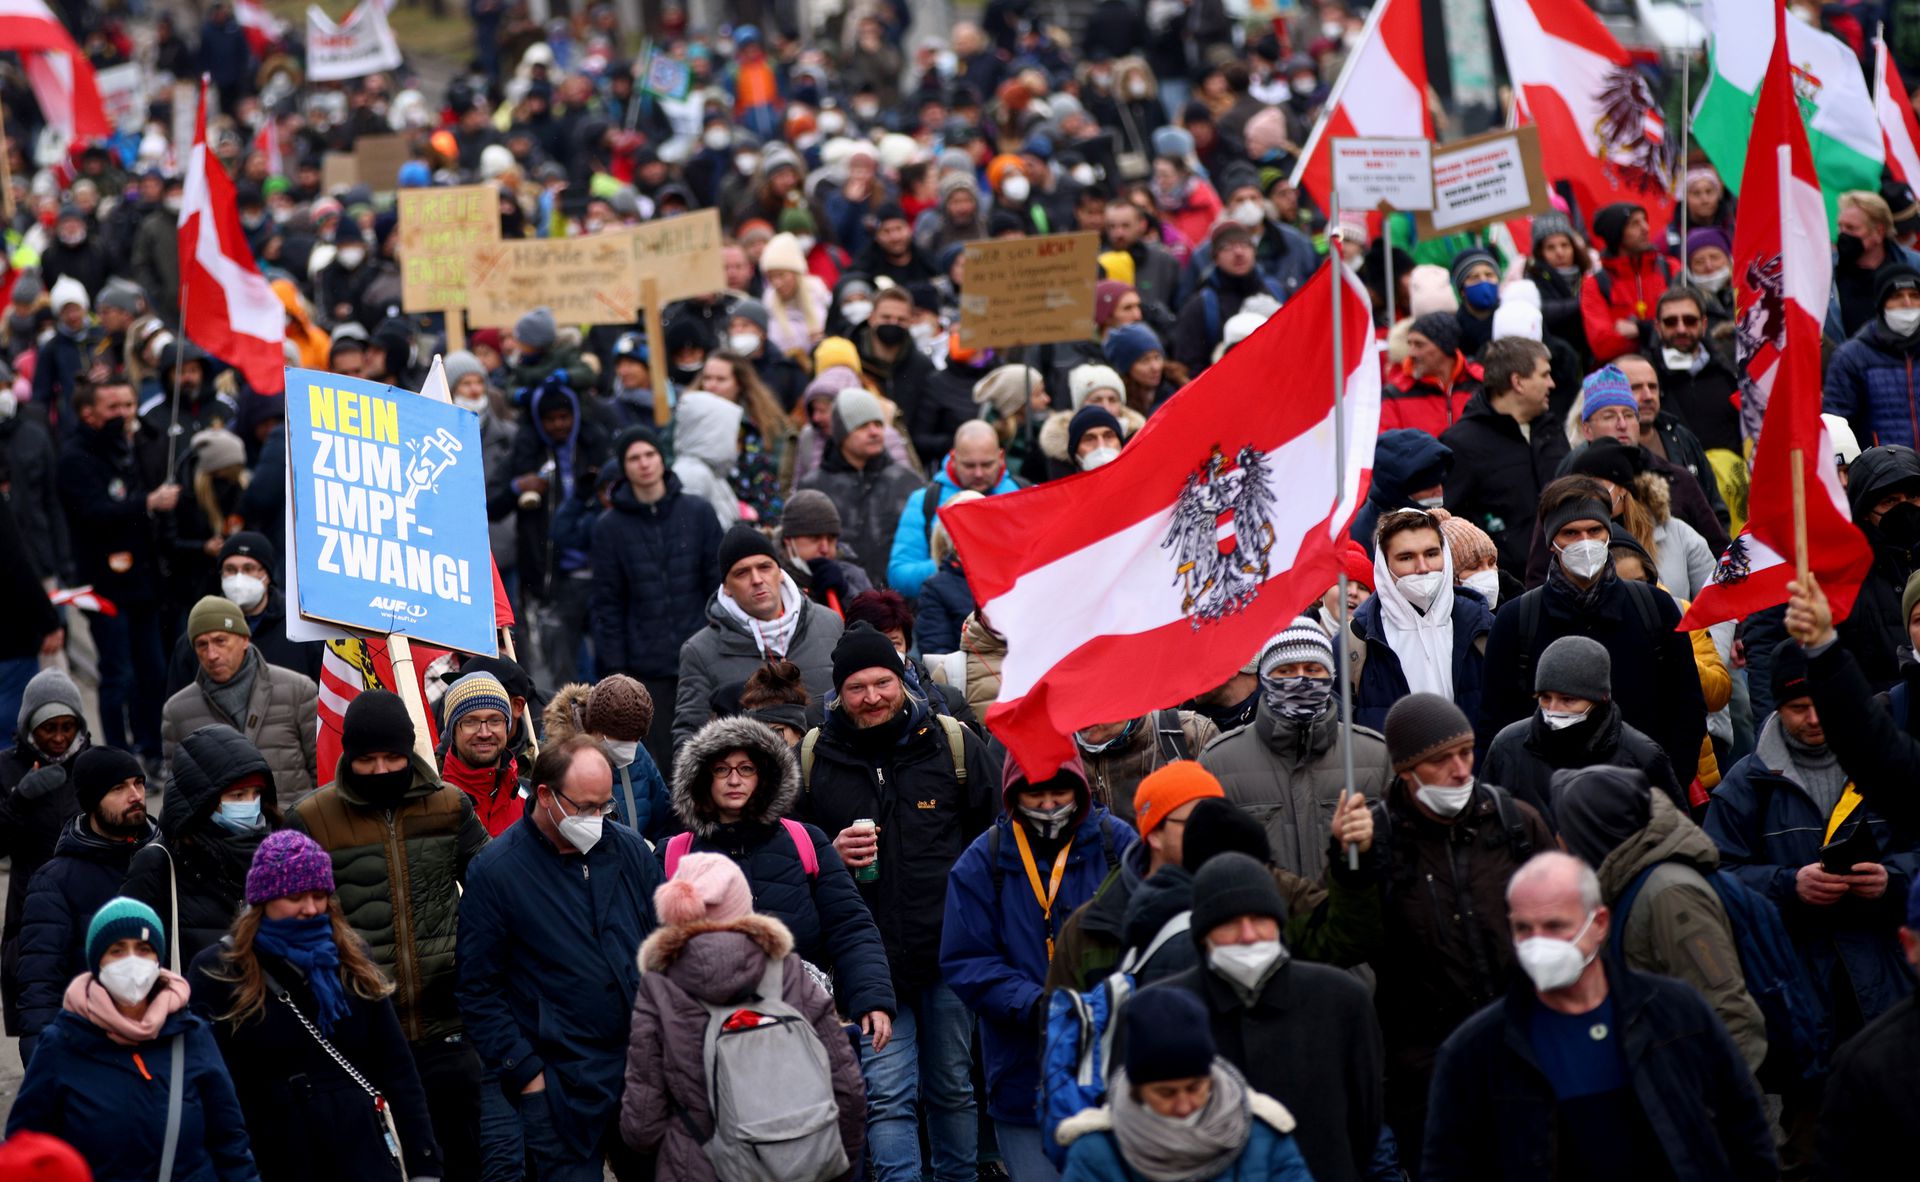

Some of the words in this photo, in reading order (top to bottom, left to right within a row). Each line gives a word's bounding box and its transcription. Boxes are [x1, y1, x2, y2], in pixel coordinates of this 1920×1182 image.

[404, 192, 485, 224] FREIE
[308, 384, 400, 445] NEIN
[311, 431, 402, 492] ZUM
[314, 478, 433, 541] IMPF-
[317, 526, 472, 605] ZWANG!
